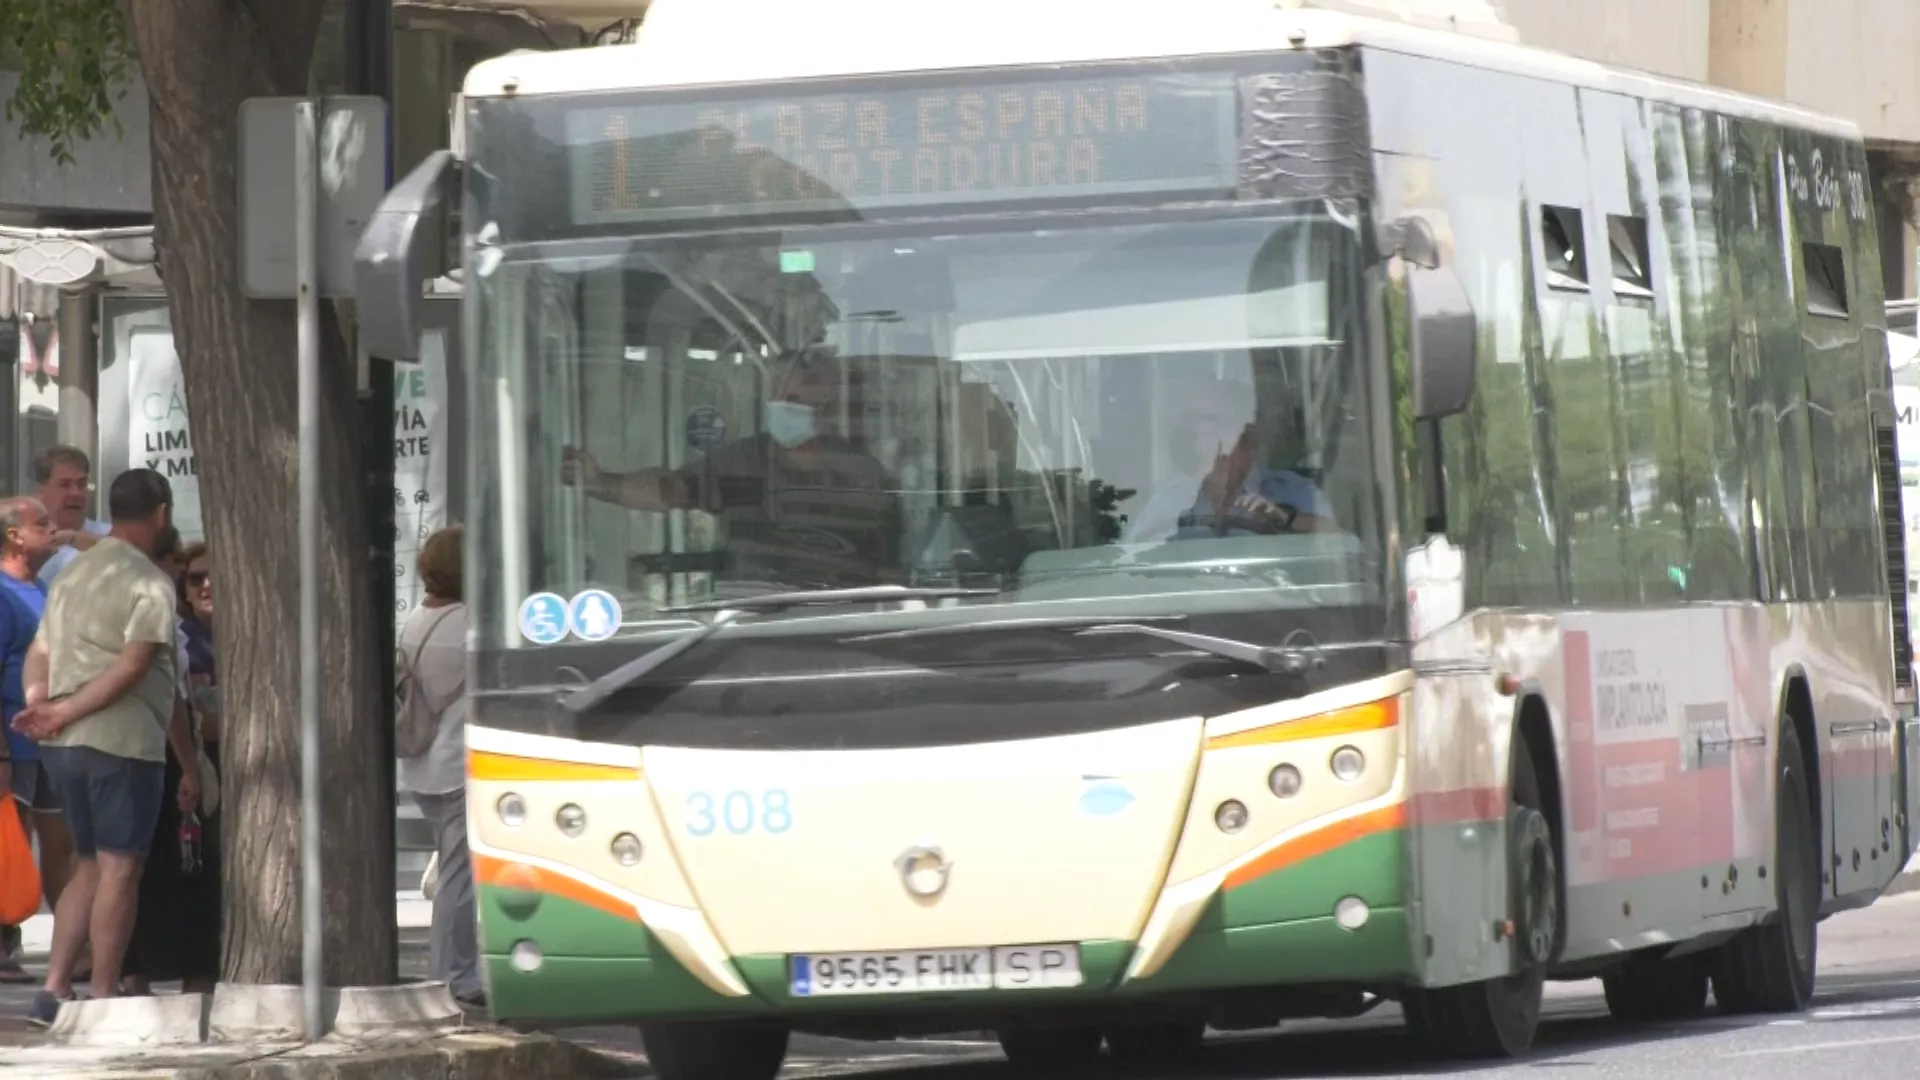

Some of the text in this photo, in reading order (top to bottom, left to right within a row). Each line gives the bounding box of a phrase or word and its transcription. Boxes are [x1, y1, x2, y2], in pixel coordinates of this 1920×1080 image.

[697, 83, 1147, 157] PLAZA ESPAÑA
[603, 115, 638, 213] 1
[685, 788, 794, 837] 308
[816, 952, 981, 990] 9565 FHK
